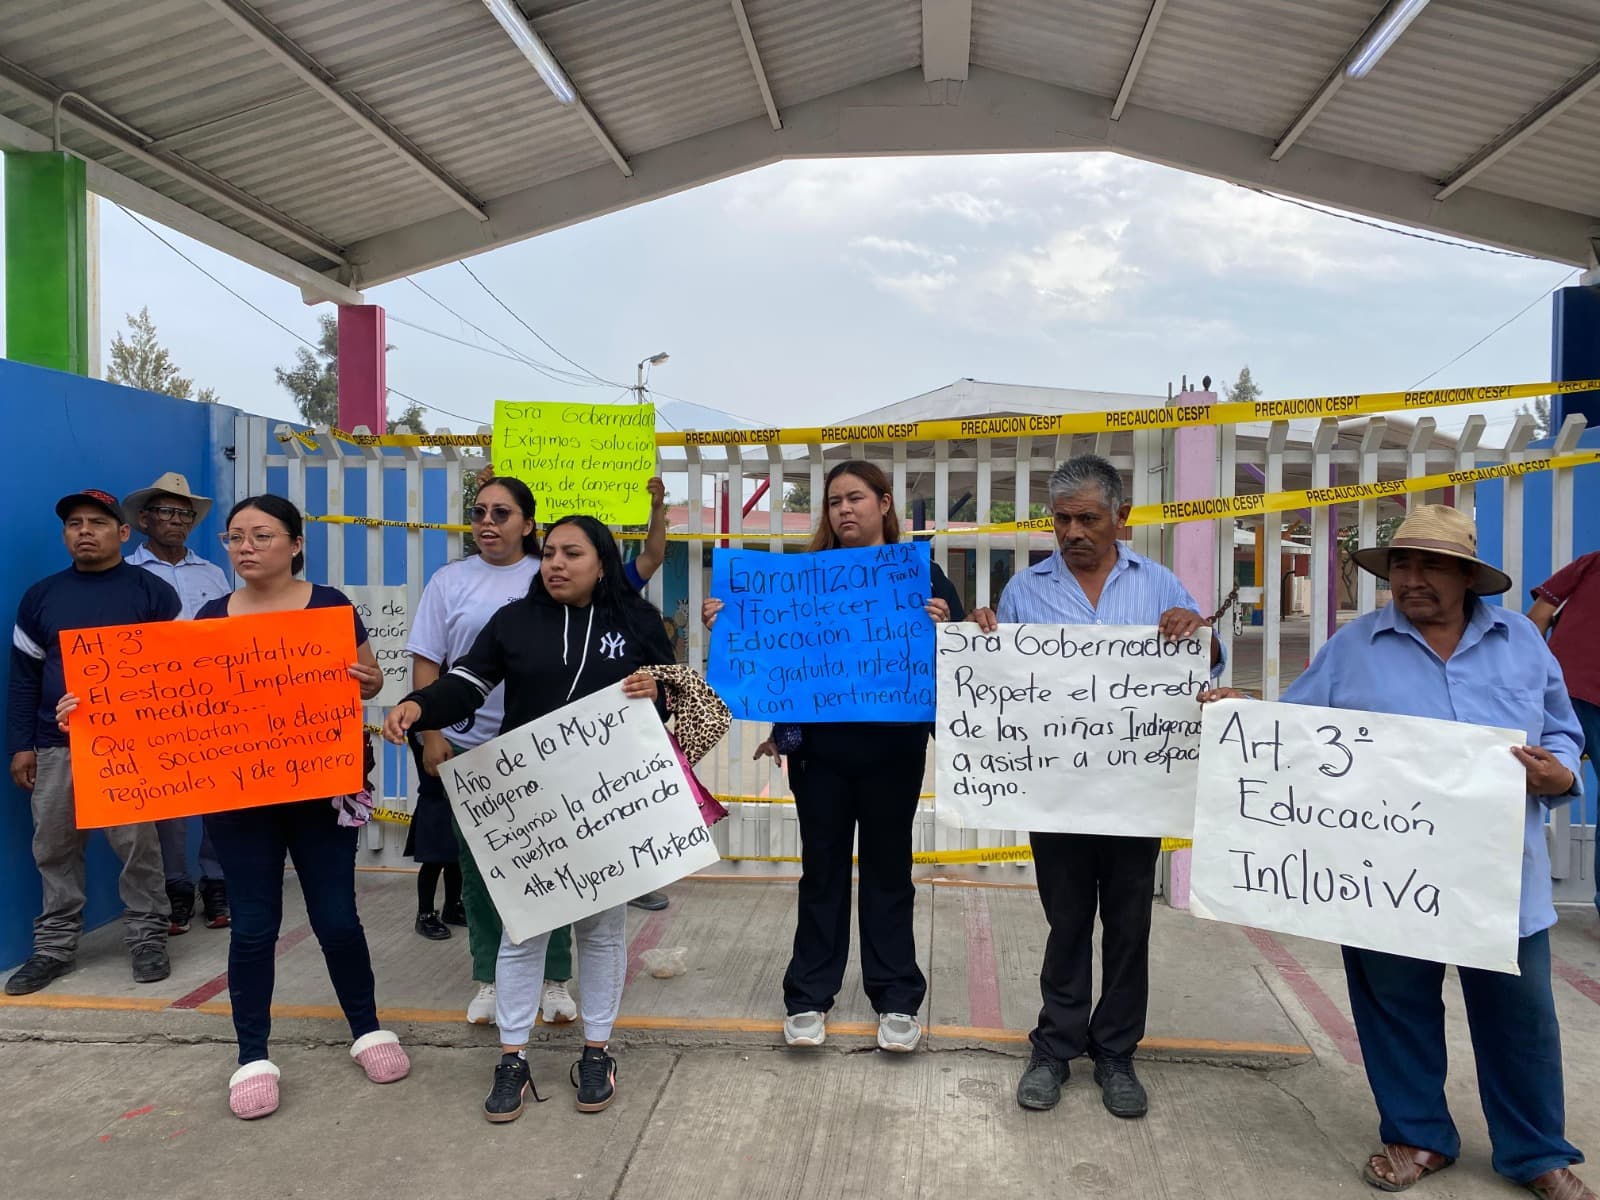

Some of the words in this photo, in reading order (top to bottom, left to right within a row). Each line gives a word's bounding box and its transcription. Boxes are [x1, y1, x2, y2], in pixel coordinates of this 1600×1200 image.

[1255, 400, 1322, 417] PRECAUCION
[1326, 396, 1360, 411] CESPT
[1404, 388, 1474, 406] PRECAUCION
[1478, 385, 1512, 399] CESPT
[504, 402, 541, 420] Sra
[1106, 408, 1174, 427] PRECAUCION
[1177, 405, 1211, 422] CESPT
[685, 431, 747, 445] PRECAUCION
[750, 429, 781, 443] CESPT
[821, 425, 883, 441] PRECAUCION
[887, 424, 919, 438] CESPT
[961, 417, 1027, 434] PRECAUCION
[1031, 415, 1062, 431] CESPT
[420, 435, 480, 447] PRECAUCION
[503, 427, 581, 456] Exigimos
[500, 459, 513, 471] a
[522, 453, 575, 471] nuestra
[1449, 466, 1515, 484] PRECAUCION
[1518, 459, 1552, 475] CESPT
[559, 475, 575, 492] de
[1306, 485, 1373, 502] PRECAUCION
[1374, 480, 1407, 494] CESPT
[546, 493, 604, 509] nuestras
[1163, 499, 1230, 518] PRECAUCION
[1233, 495, 1265, 511] CESPT
[875, 545, 896, 562] Art
[729, 557, 898, 595] Garantizar
[381, 600, 405, 616] de
[940, 624, 1000, 656] Sra
[116, 659, 182, 678] Sera
[729, 659, 756, 680] na
[858, 650, 935, 692] integral
[89, 686, 111, 706] El
[119, 680, 214, 703] estado
[954, 665, 1052, 715] Respete
[1067, 674, 1096, 703] el
[88, 710, 116, 726] ra
[757, 698, 793, 714] con
[91, 735, 136, 758] Que
[147, 721, 249, 750] combatan
[267, 712, 286, 732] la
[949, 711, 986, 738] de
[997, 716, 1028, 742] las
[1043, 715, 1114, 740] niñas
[453, 768, 491, 795] Año
[496, 749, 527, 776] de
[531, 732, 557, 761] la
[558, 705, 630, 747] Mujer
[1218, 711, 1291, 772] Art.
[99, 754, 139, 779] dad
[952, 752, 971, 773] a
[980, 745, 1060, 773] asistir
[1073, 752, 1088, 768] a
[1107, 750, 1136, 767] un
[1144, 744, 1200, 773] espaci
[102, 771, 216, 810] regionales
[251, 759, 275, 782] de
[286, 752, 355, 787] genero
[561, 794, 584, 821] la
[591, 753, 673, 805] atención
[953, 777, 1027, 806] digno.
[1238, 777, 1434, 835] Educación
[490, 866, 505, 880] a
[512, 835, 568, 871] nuestra
[575, 780, 679, 840] demanda
[554, 860, 625, 902] Mujeres
[628, 824, 710, 869] Mixtecas
[1229, 848, 1440, 917] Inclusiva
